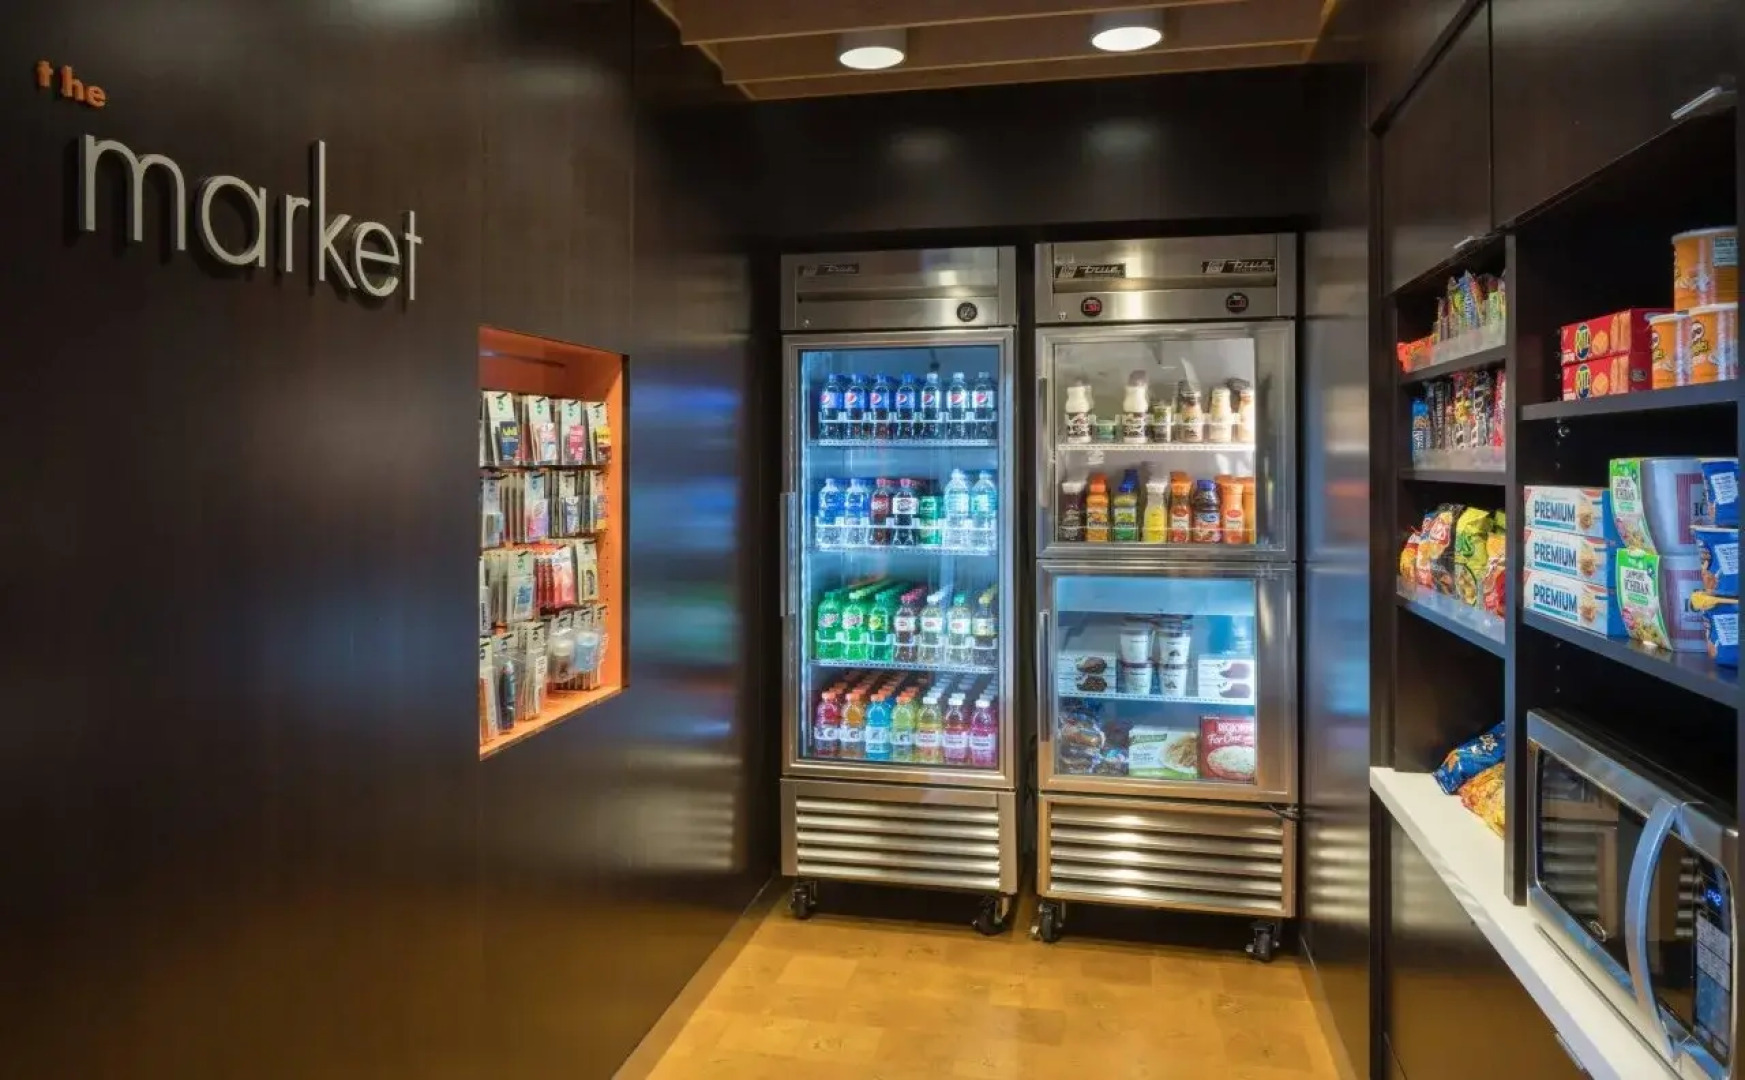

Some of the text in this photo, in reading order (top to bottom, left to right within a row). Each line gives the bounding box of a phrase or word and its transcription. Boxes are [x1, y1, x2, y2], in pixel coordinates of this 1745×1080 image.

[36, 60, 107, 108] the
[78, 133, 423, 301] market
[1534, 500, 1576, 523] PREMIUM
[1534, 541, 1577, 568] PREMIUM
[1533, 583, 1578, 614] PREMIUM
